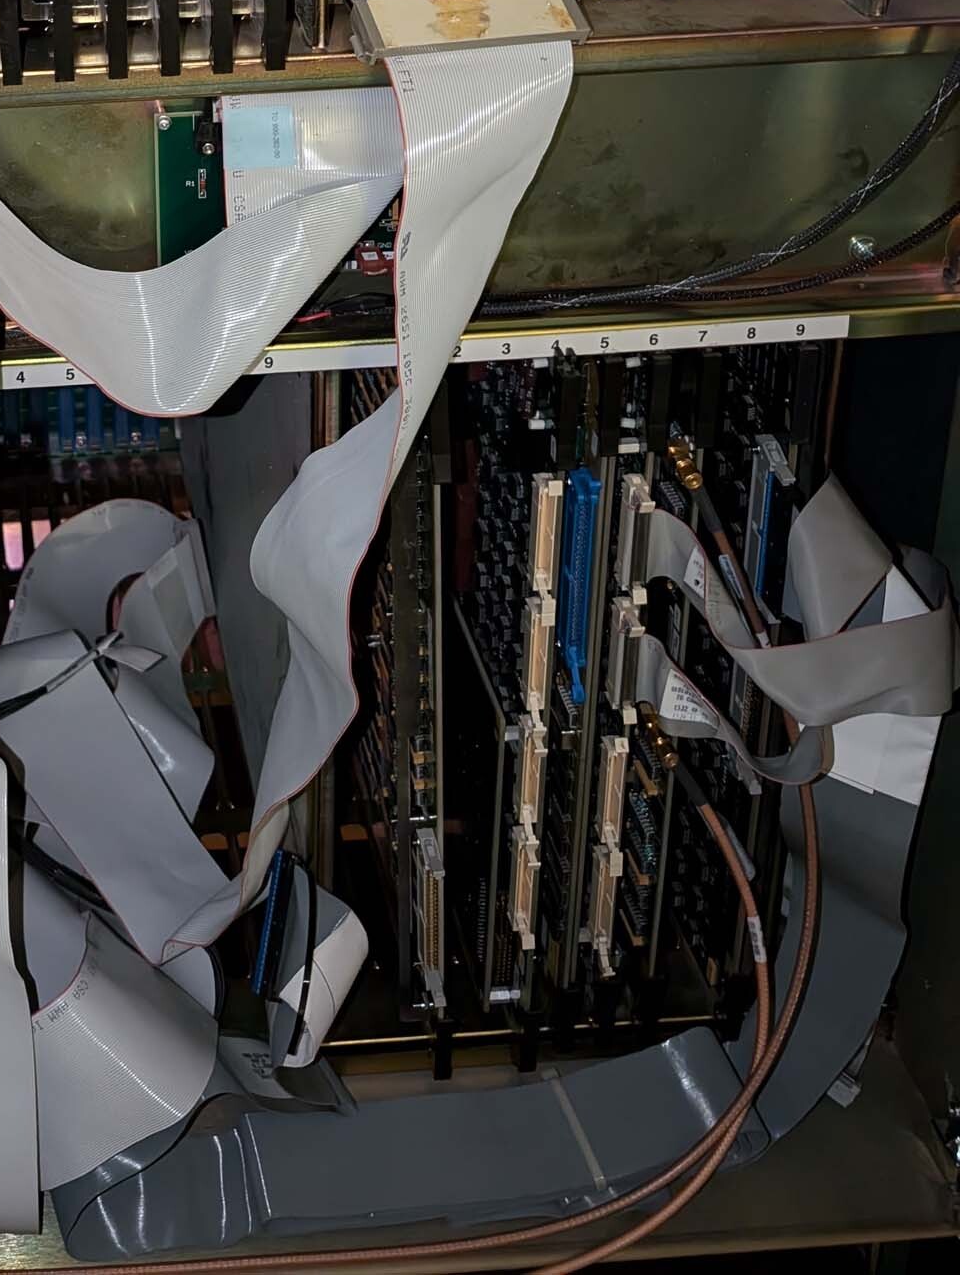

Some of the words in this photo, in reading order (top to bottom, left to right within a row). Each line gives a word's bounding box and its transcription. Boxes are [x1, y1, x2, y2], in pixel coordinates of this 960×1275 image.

[451, 345, 462, 359] 2
[501, 342, 511, 355] 3
[600, 336, 610, 349] 5
[649, 333, 659, 346] 6
[698, 330, 708, 342] 7
[746, 326, 757, 340] 8
[796, 323, 806, 336] 9
[15, 371, 26, 384] 4
[65, 367, 76, 381] 5
[264, 356, 274, 369] 9
